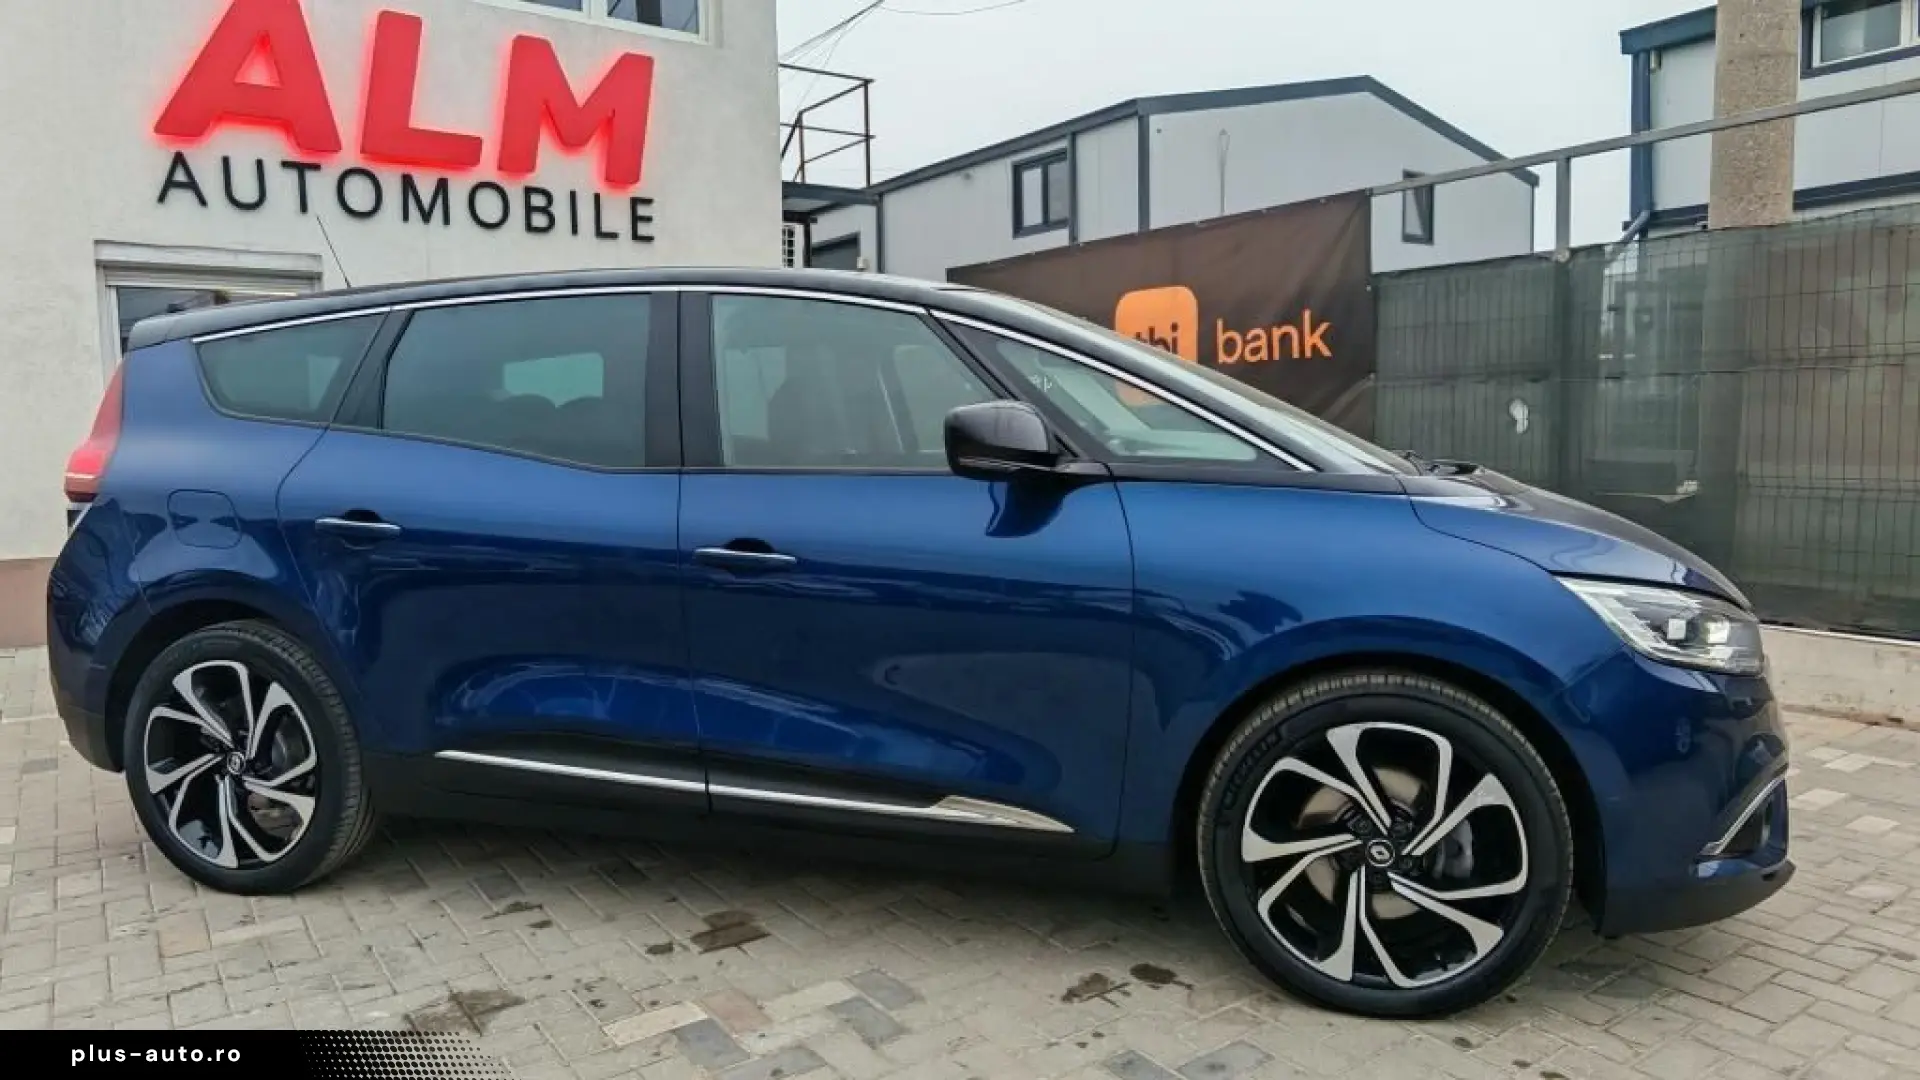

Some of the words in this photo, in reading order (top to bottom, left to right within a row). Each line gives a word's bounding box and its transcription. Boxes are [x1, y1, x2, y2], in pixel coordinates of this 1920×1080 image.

[153, 0, 655, 186] ALM
[157, 151, 656, 243] AUTOMOBILE
[1216, 308, 1332, 364] bank
